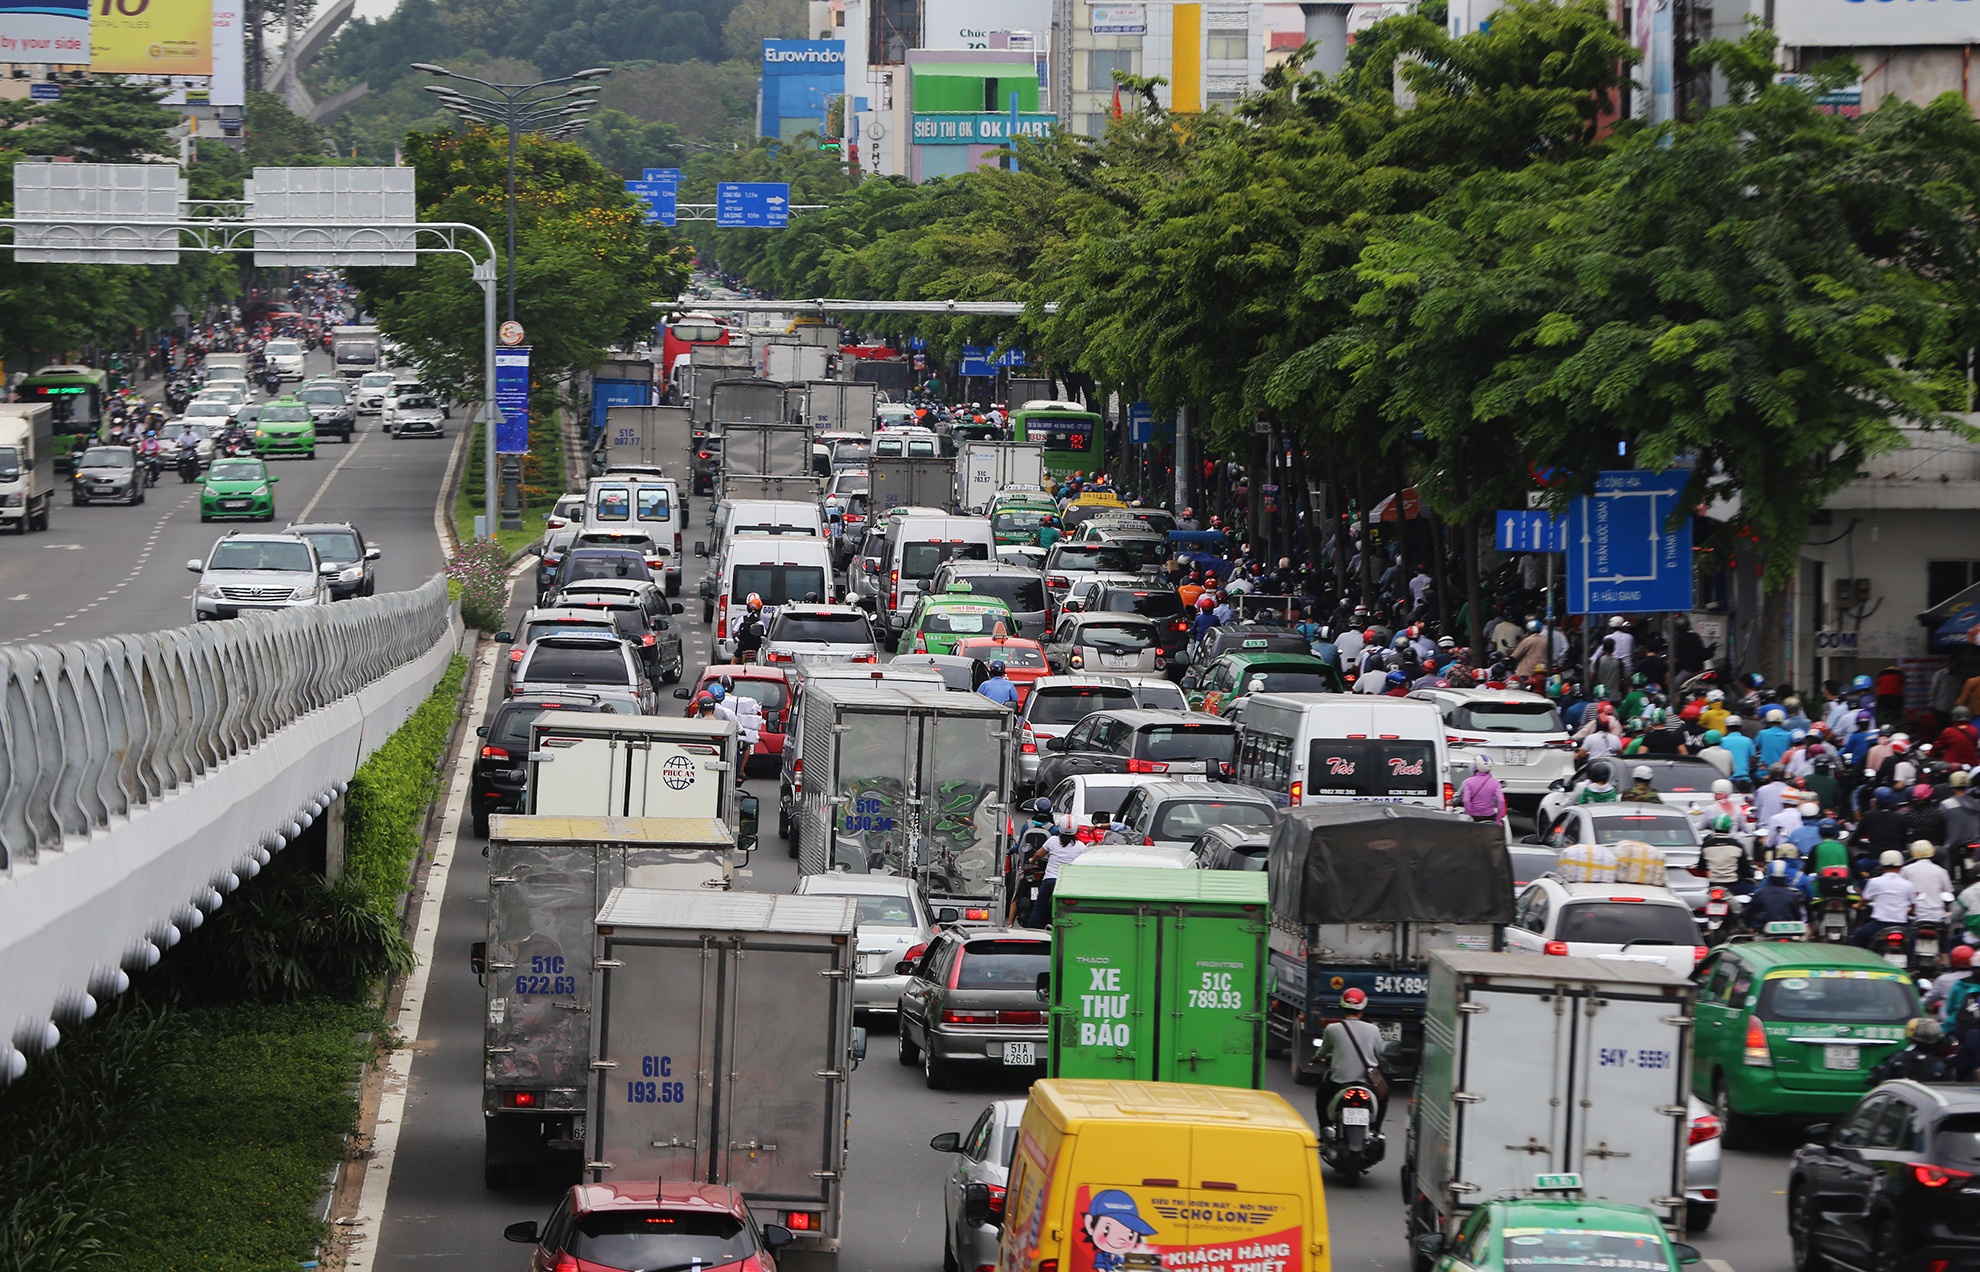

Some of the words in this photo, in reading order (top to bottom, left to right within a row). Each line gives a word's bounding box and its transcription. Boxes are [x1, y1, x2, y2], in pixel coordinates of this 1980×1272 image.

[960, 28, 988, 38] Chúc
[1, 36, 17, 50] by
[21, 38, 51, 51] your
[54, 36, 82, 50] side
[959, 121, 973, 138] OK
[980, 120, 1002, 138] OK
[619, 428, 635, 437] 51C
[1029, 433, 1048, 441] BUS
[663, 769, 683, 777] PHUC
[856, 798, 880, 814] 51C
[531, 955, 565, 975] 51C
[1075, 956, 1110, 965] THACO
[1196, 960, 1245, 969] FRONTIER
[516, 975, 575, 995] 622.63
[1089, 968, 1121, 991] XE
[1202, 972, 1232, 991] 51C
[1081, 994, 1130, 1019] THƯ
[1188, 989, 1242, 1010] 789.93
[1081, 1019, 1130, 1047] BÁO
[1010, 1043, 1029, 1054] 51A
[642, 1055, 671, 1077] 61C
[627, 1081, 685, 1104] 193.58
[1168, 1247, 1233, 1266] KHÁCH
[1237, 1242, 1291, 1261] HÀNG
